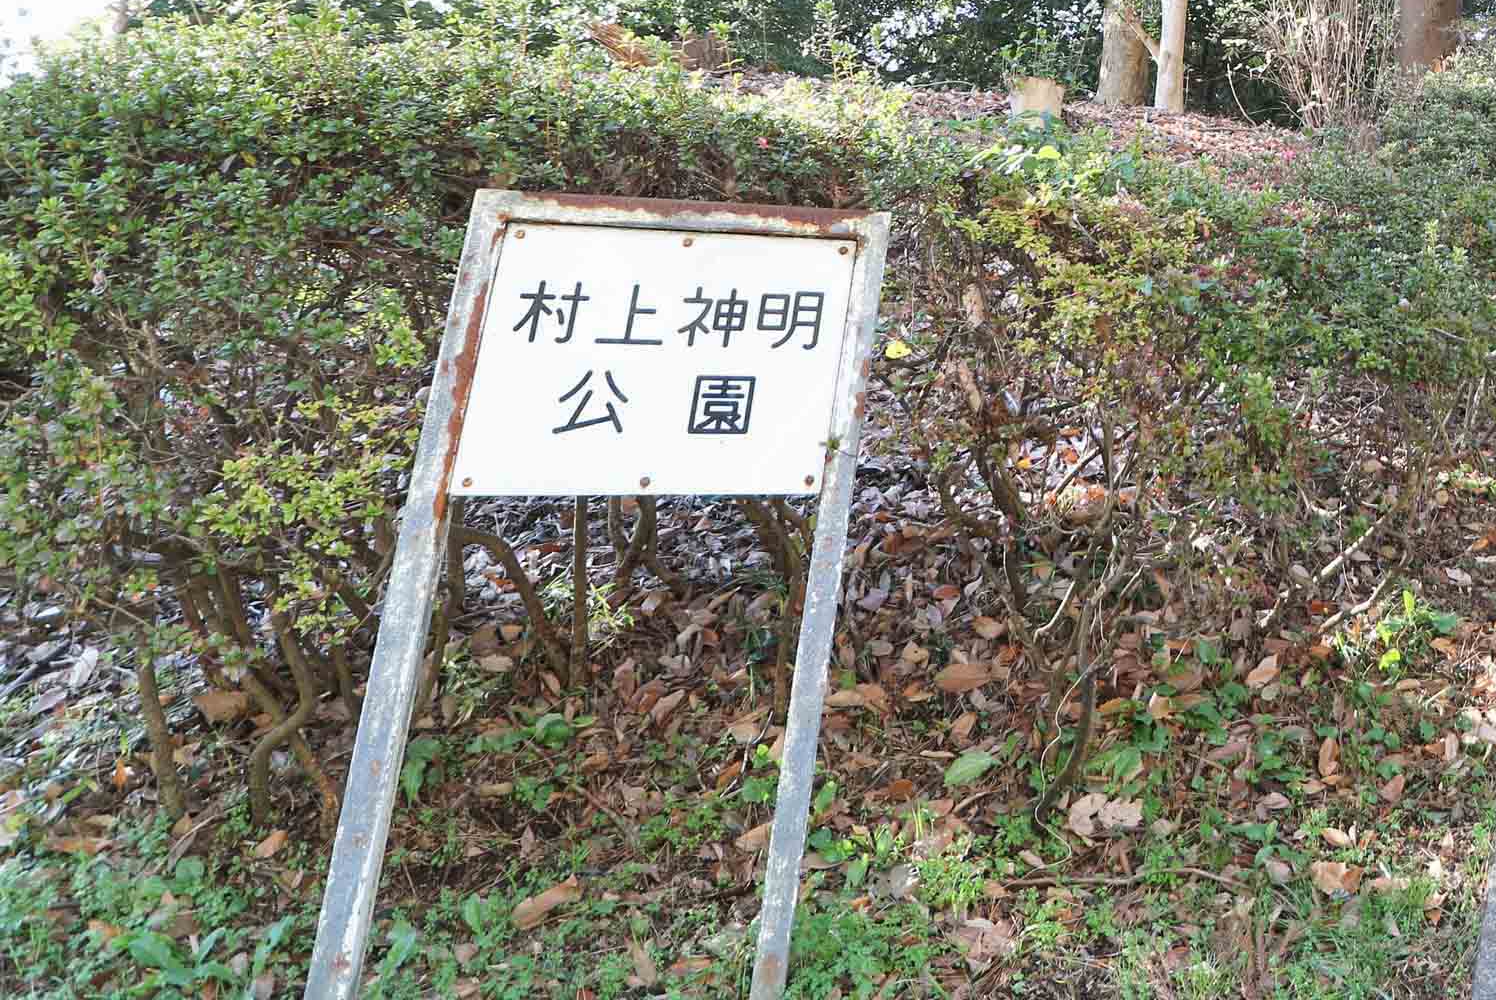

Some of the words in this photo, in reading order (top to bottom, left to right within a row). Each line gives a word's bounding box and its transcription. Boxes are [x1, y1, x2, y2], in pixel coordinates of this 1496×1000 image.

[512, 279, 826, 351] 村上神明
[551, 369, 758, 436] 公園
